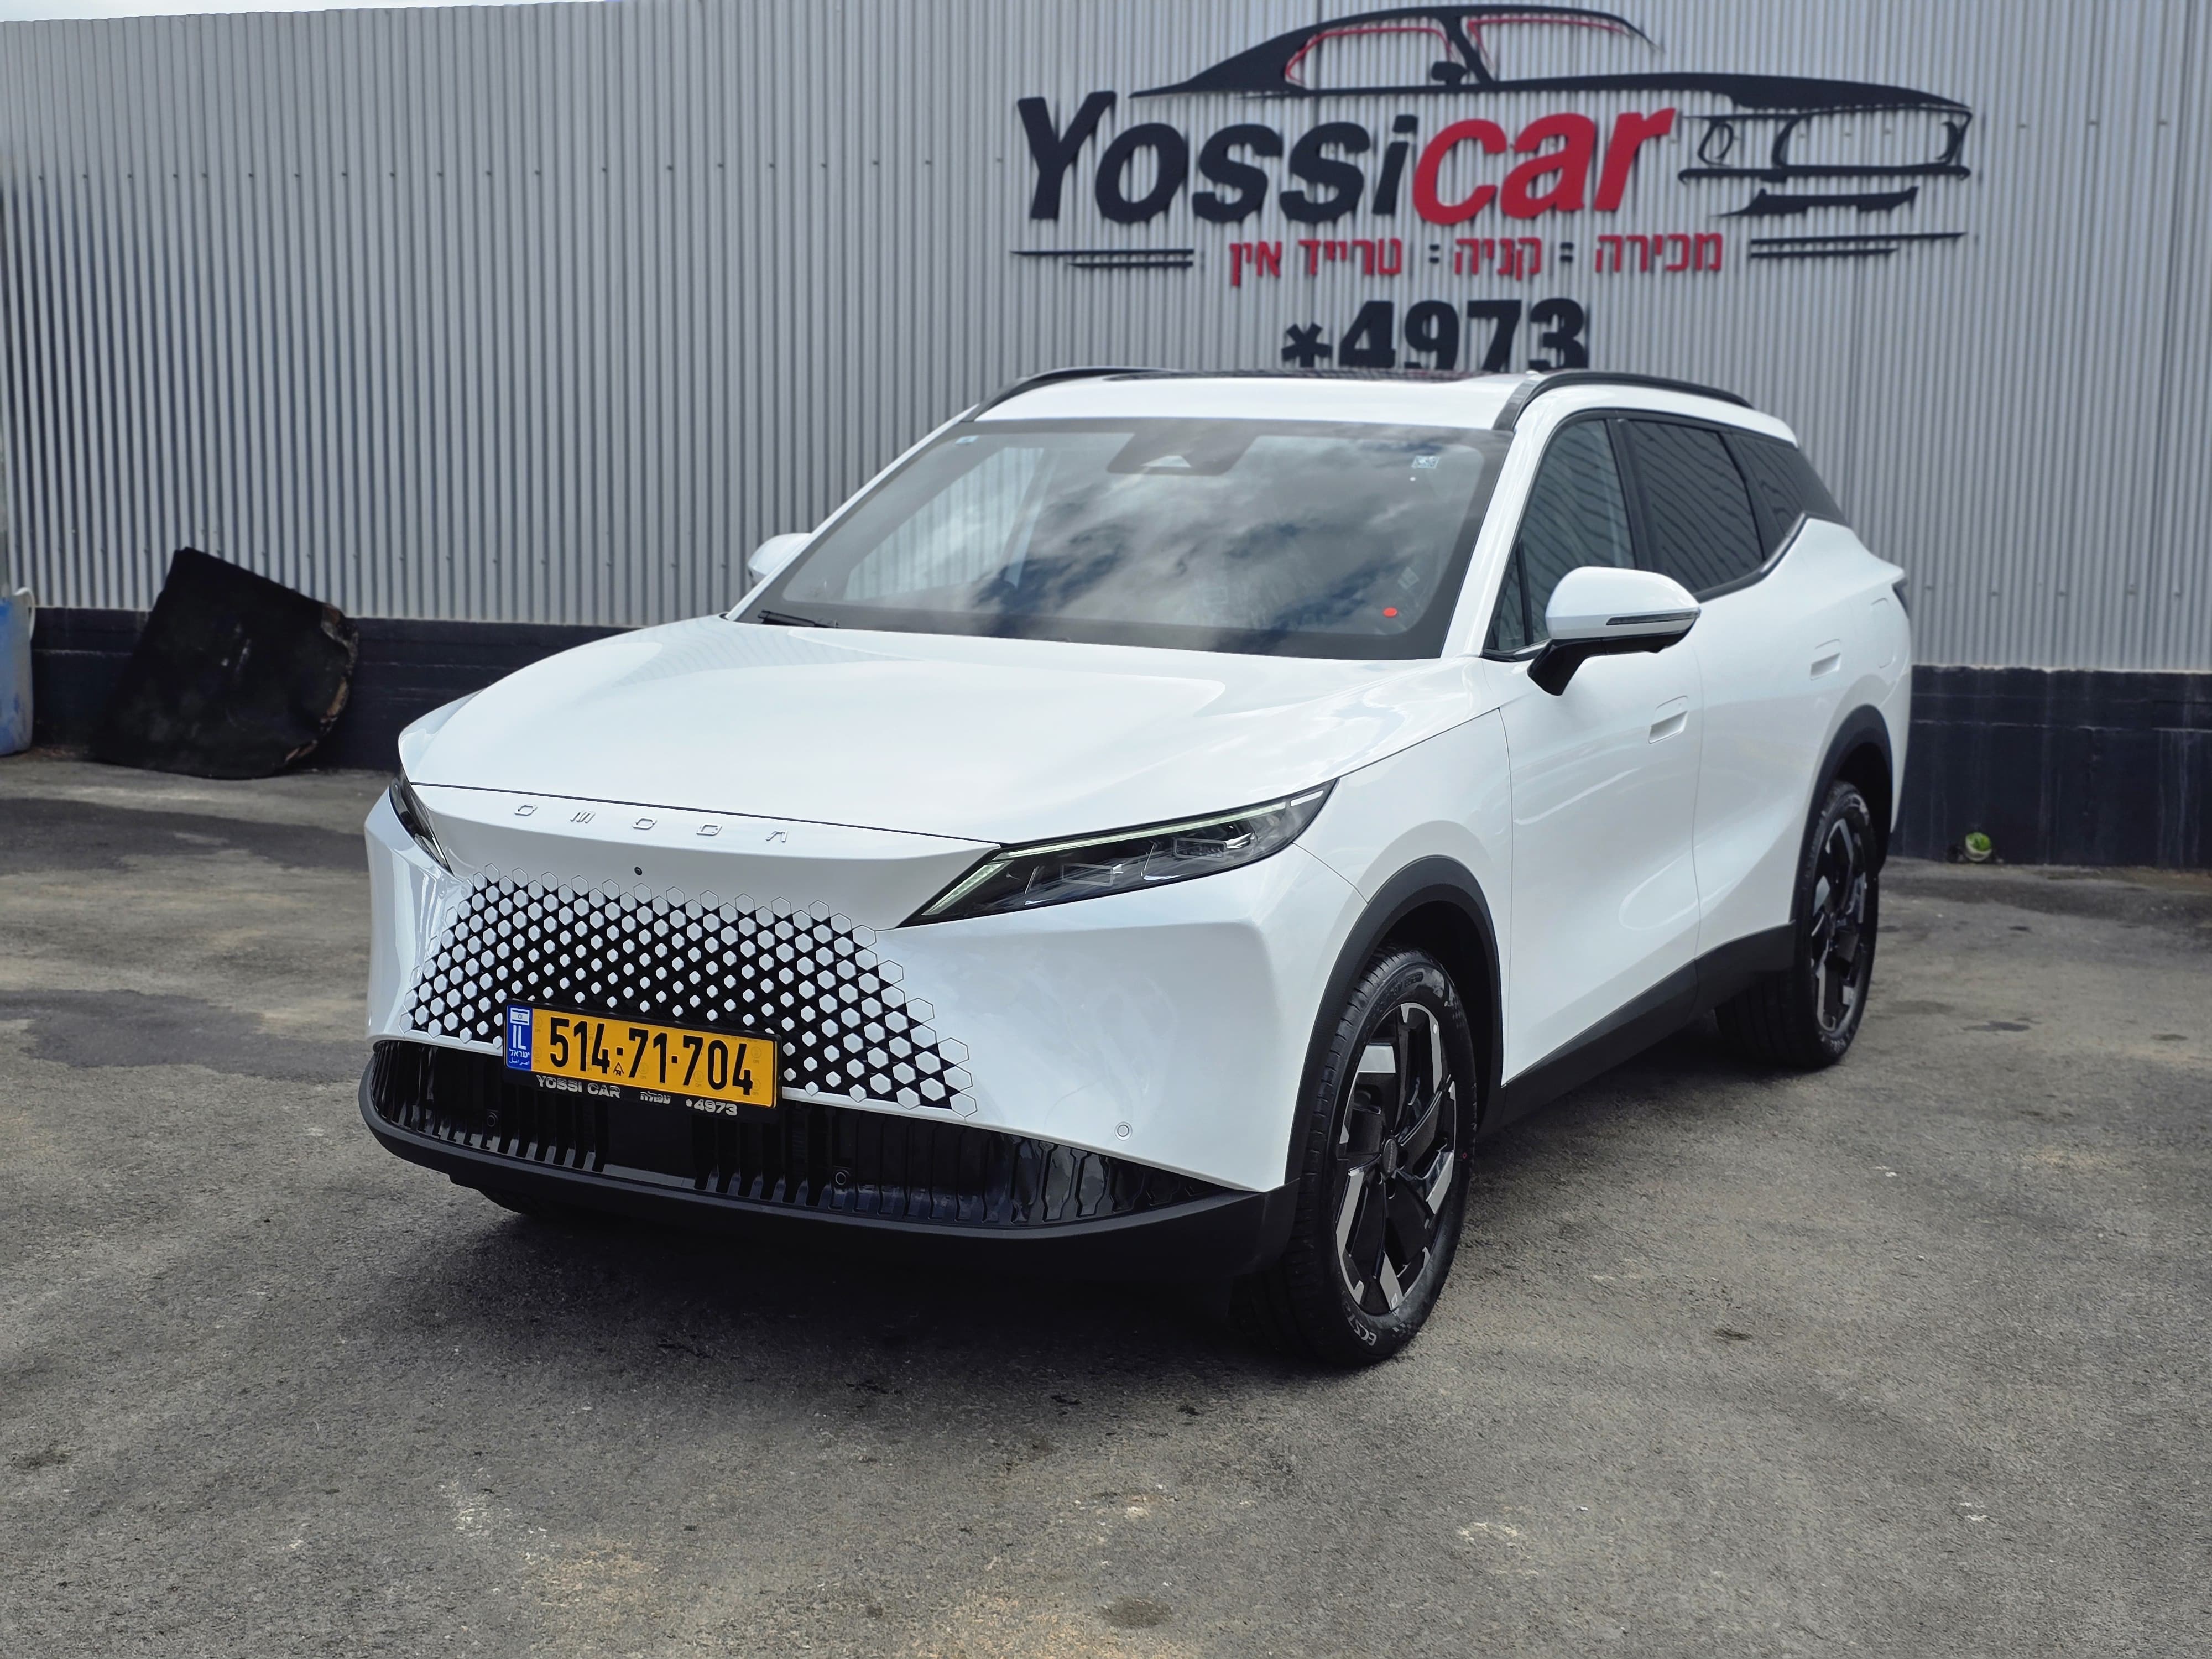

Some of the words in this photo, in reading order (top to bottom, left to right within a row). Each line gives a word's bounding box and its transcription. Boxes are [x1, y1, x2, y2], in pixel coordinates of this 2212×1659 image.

[1017, 91, 1676, 225] Yossicar
[1229, 239, 1282, 286] אין
[1298, 238, 1402, 276] טרייד
[1455, 237, 1543, 281] קניה
[1595, 233, 1723, 273] מכירה
[514, 804, 789, 843] OMODA
[509, 1048, 530, 1058] ישראל
[513, 1024, 526, 1050] IL
[536, 1074, 582, 1093] YOSSI
[587, 1082, 620, 1099] CAR
